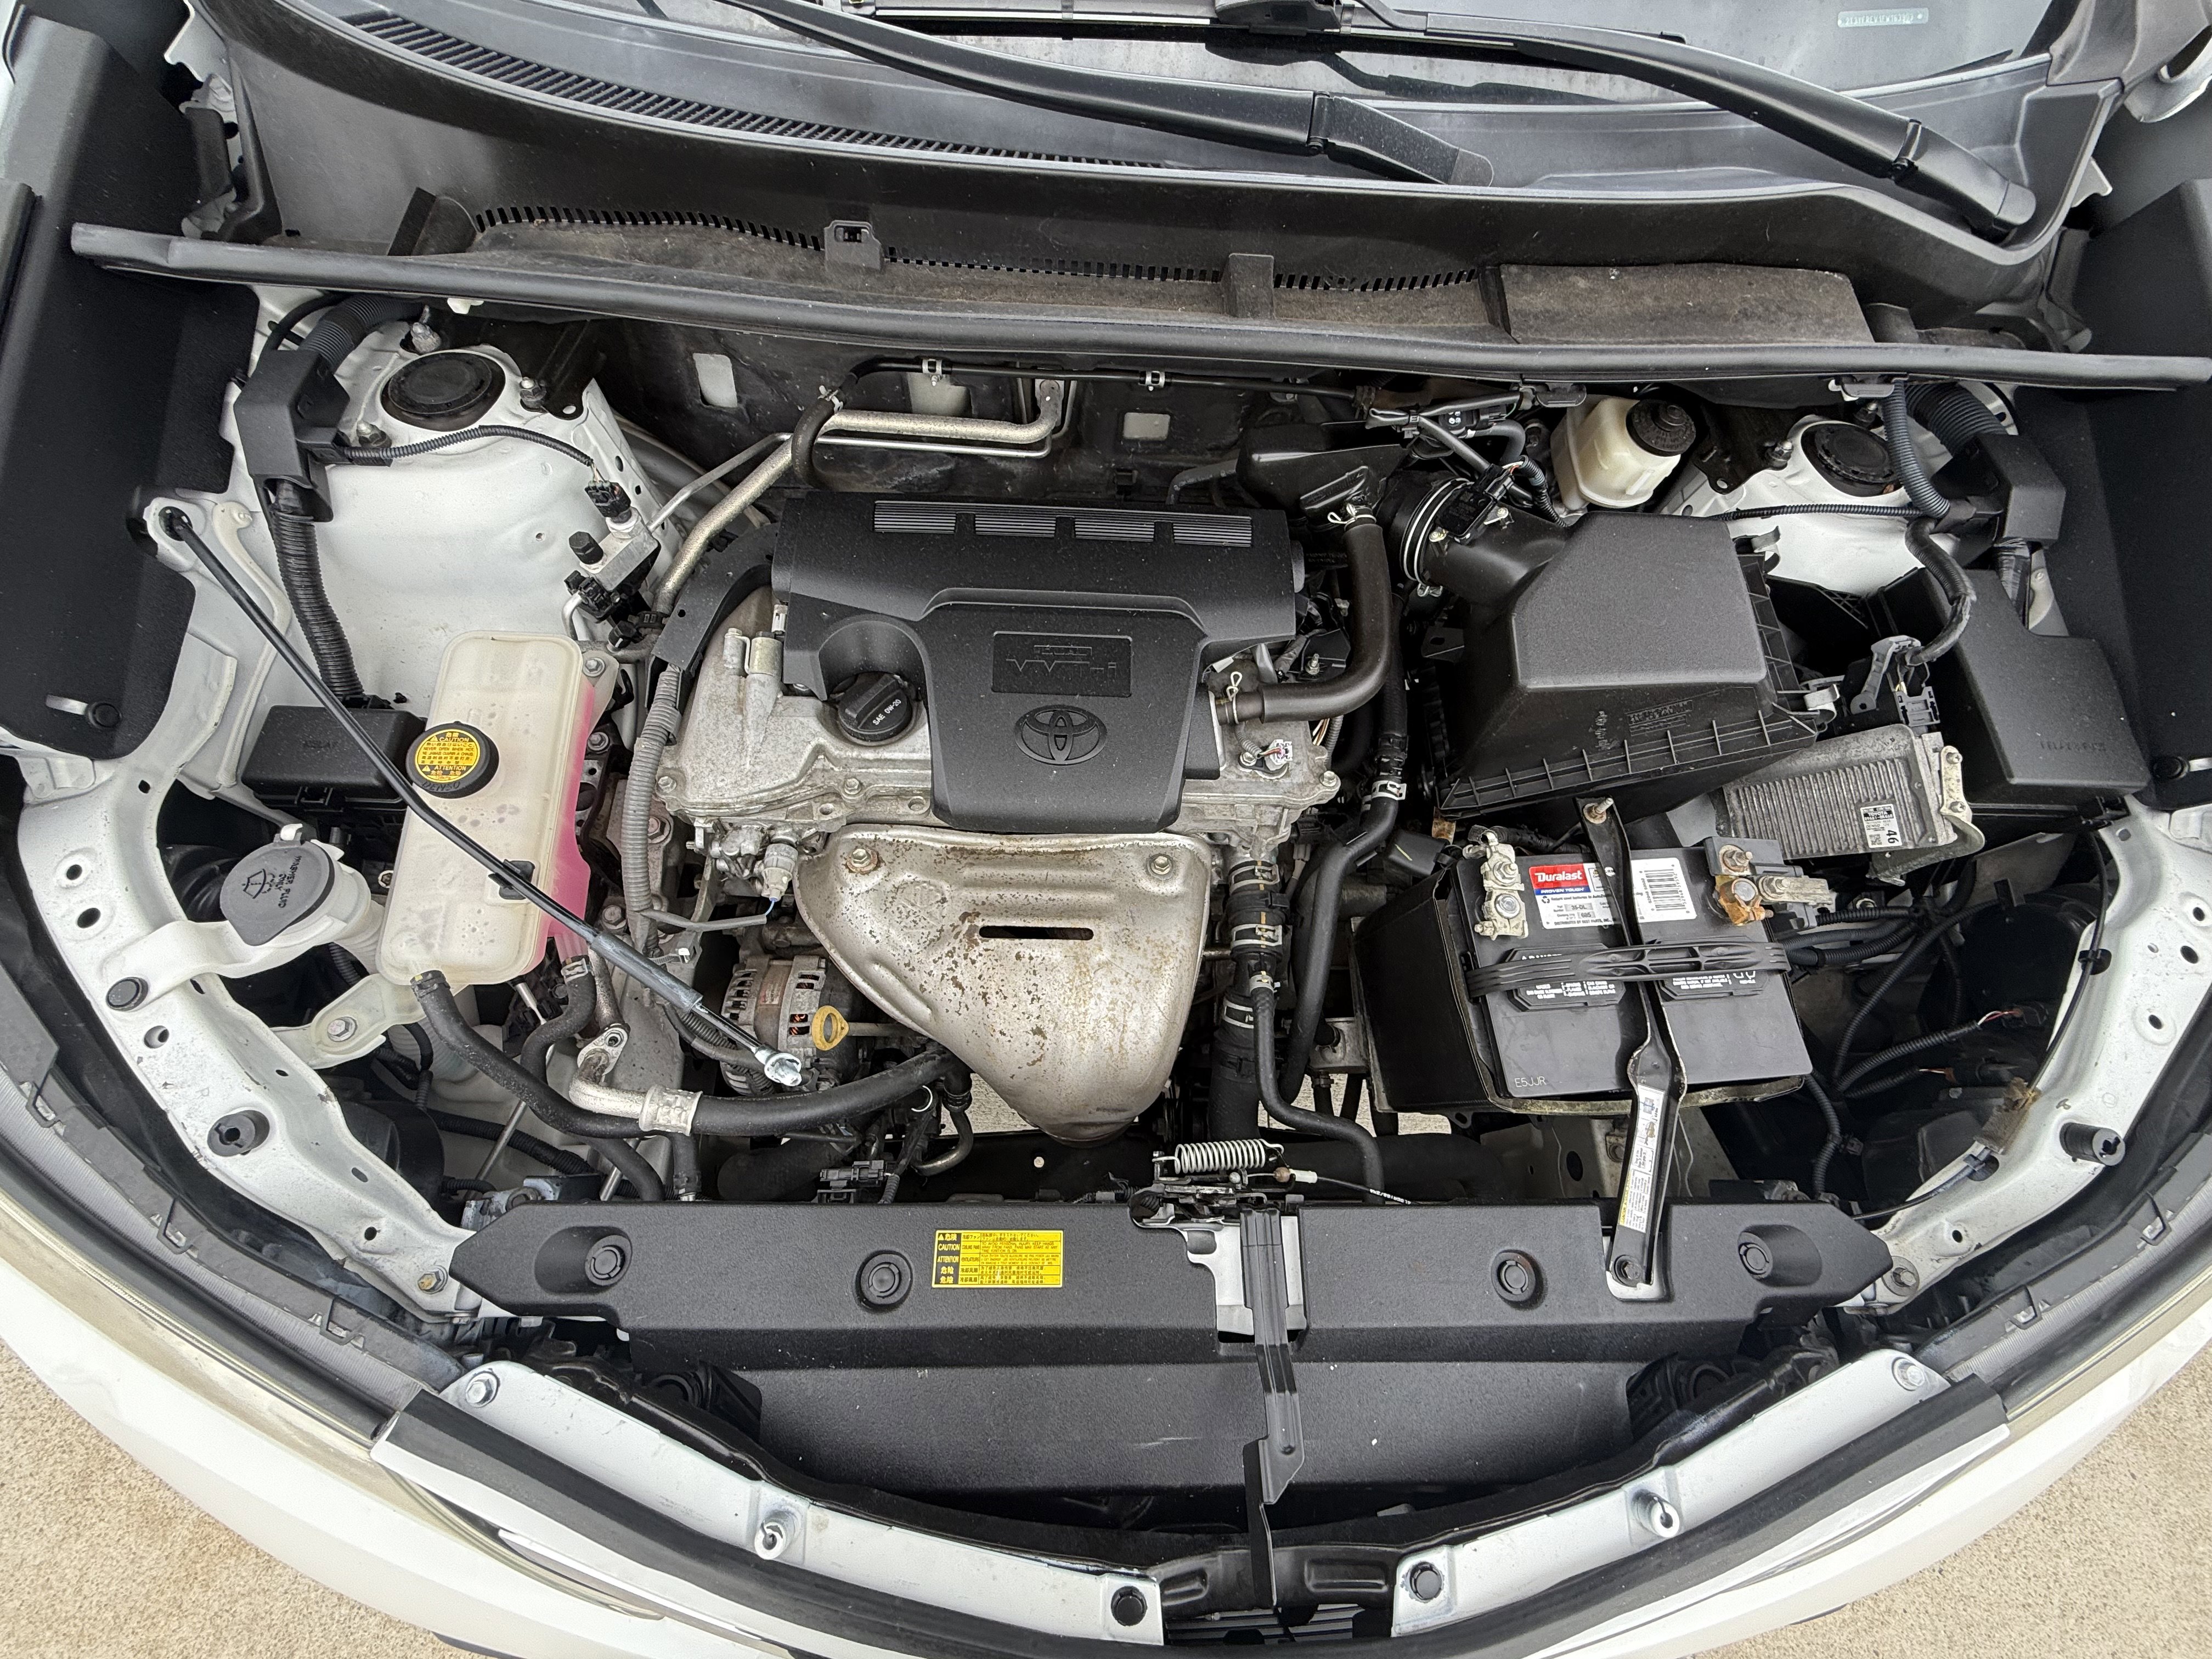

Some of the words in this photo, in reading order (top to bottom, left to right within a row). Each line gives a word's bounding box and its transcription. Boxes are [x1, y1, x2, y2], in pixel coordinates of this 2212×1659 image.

[872, 713, 886, 725] SAE
[884, 699, 901, 714] 0W-20
[421, 781, 460, 791] DENSO
[1886, 830, 1899, 843] 46
[1534, 870, 1582, 883] Duralast
[278, 888, 291, 908] FLUID
[1514, 1076, 1547, 1087] E5JJR
